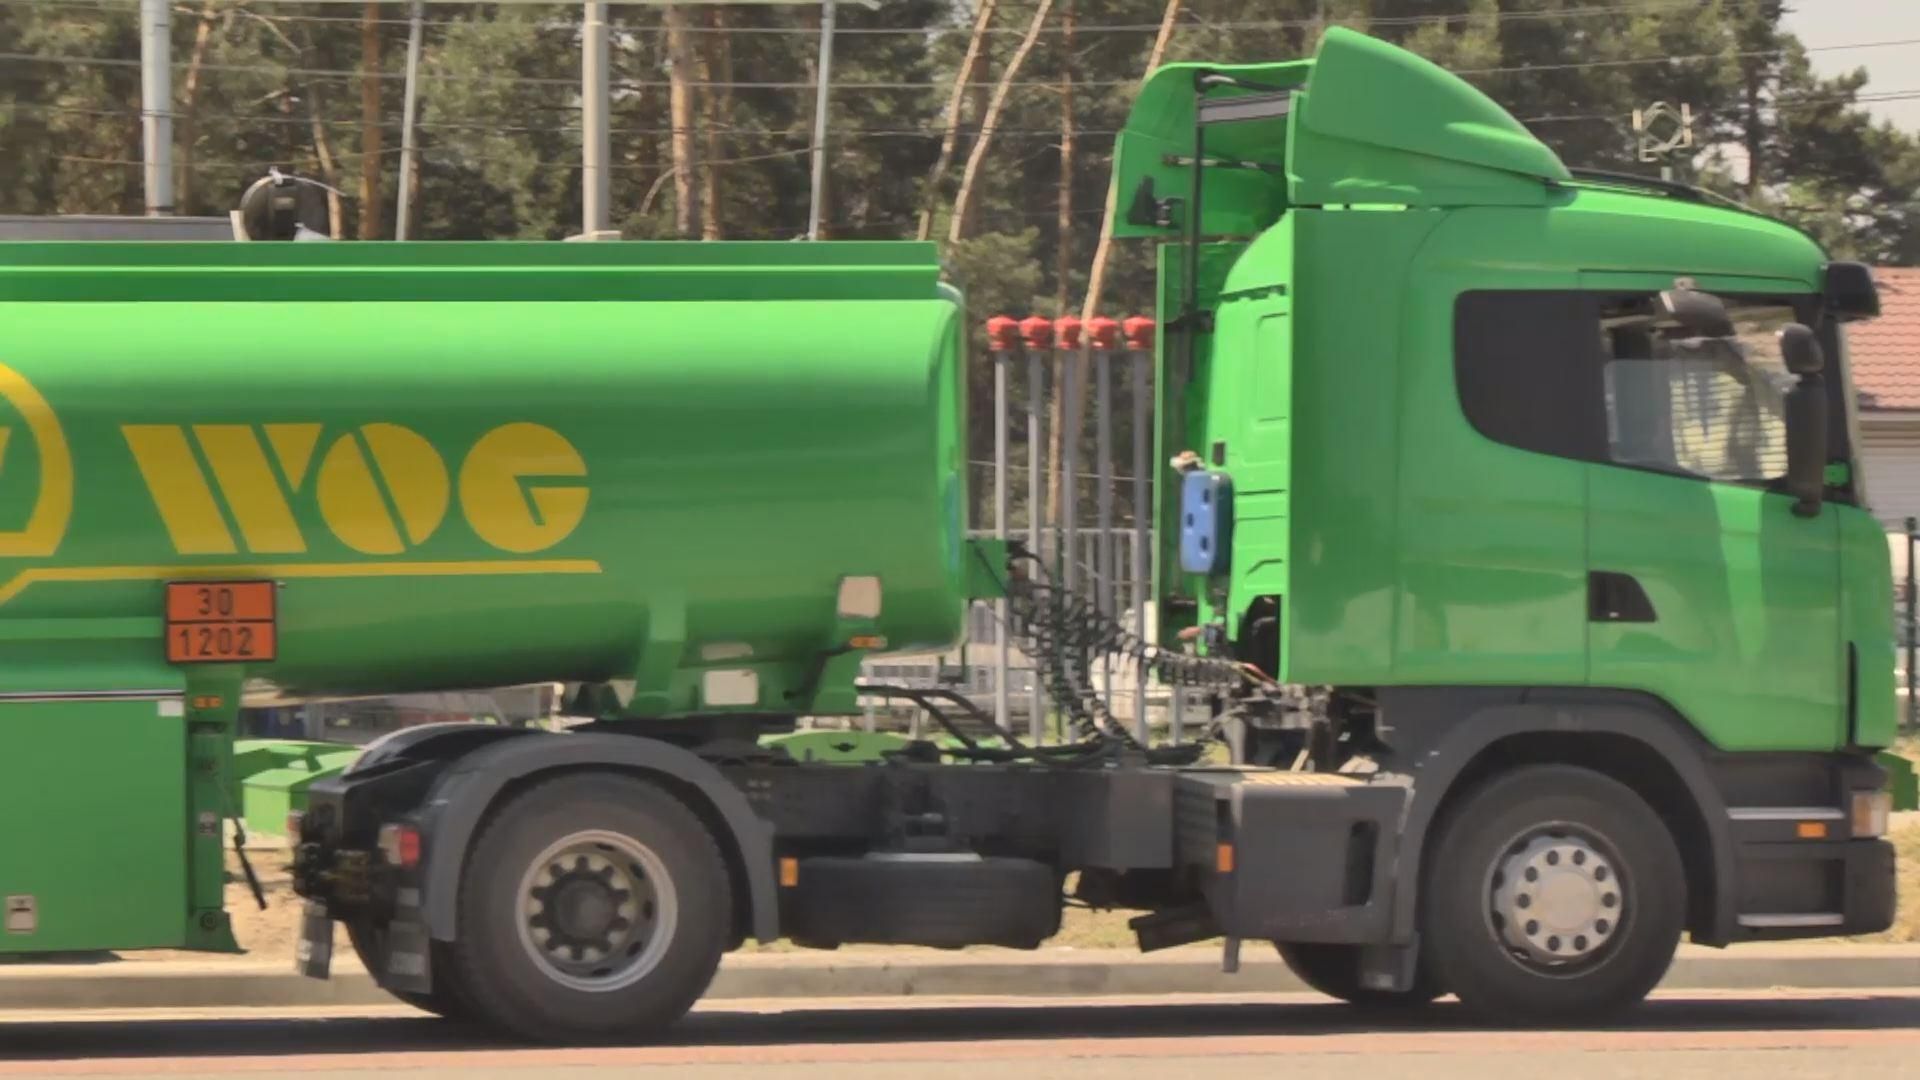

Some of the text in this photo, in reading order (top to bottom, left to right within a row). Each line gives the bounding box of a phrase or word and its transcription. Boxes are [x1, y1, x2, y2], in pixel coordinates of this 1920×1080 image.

[120, 422, 591, 555] WOG
[198, 587, 234, 616] 30
[179, 627, 255, 657] 1202
